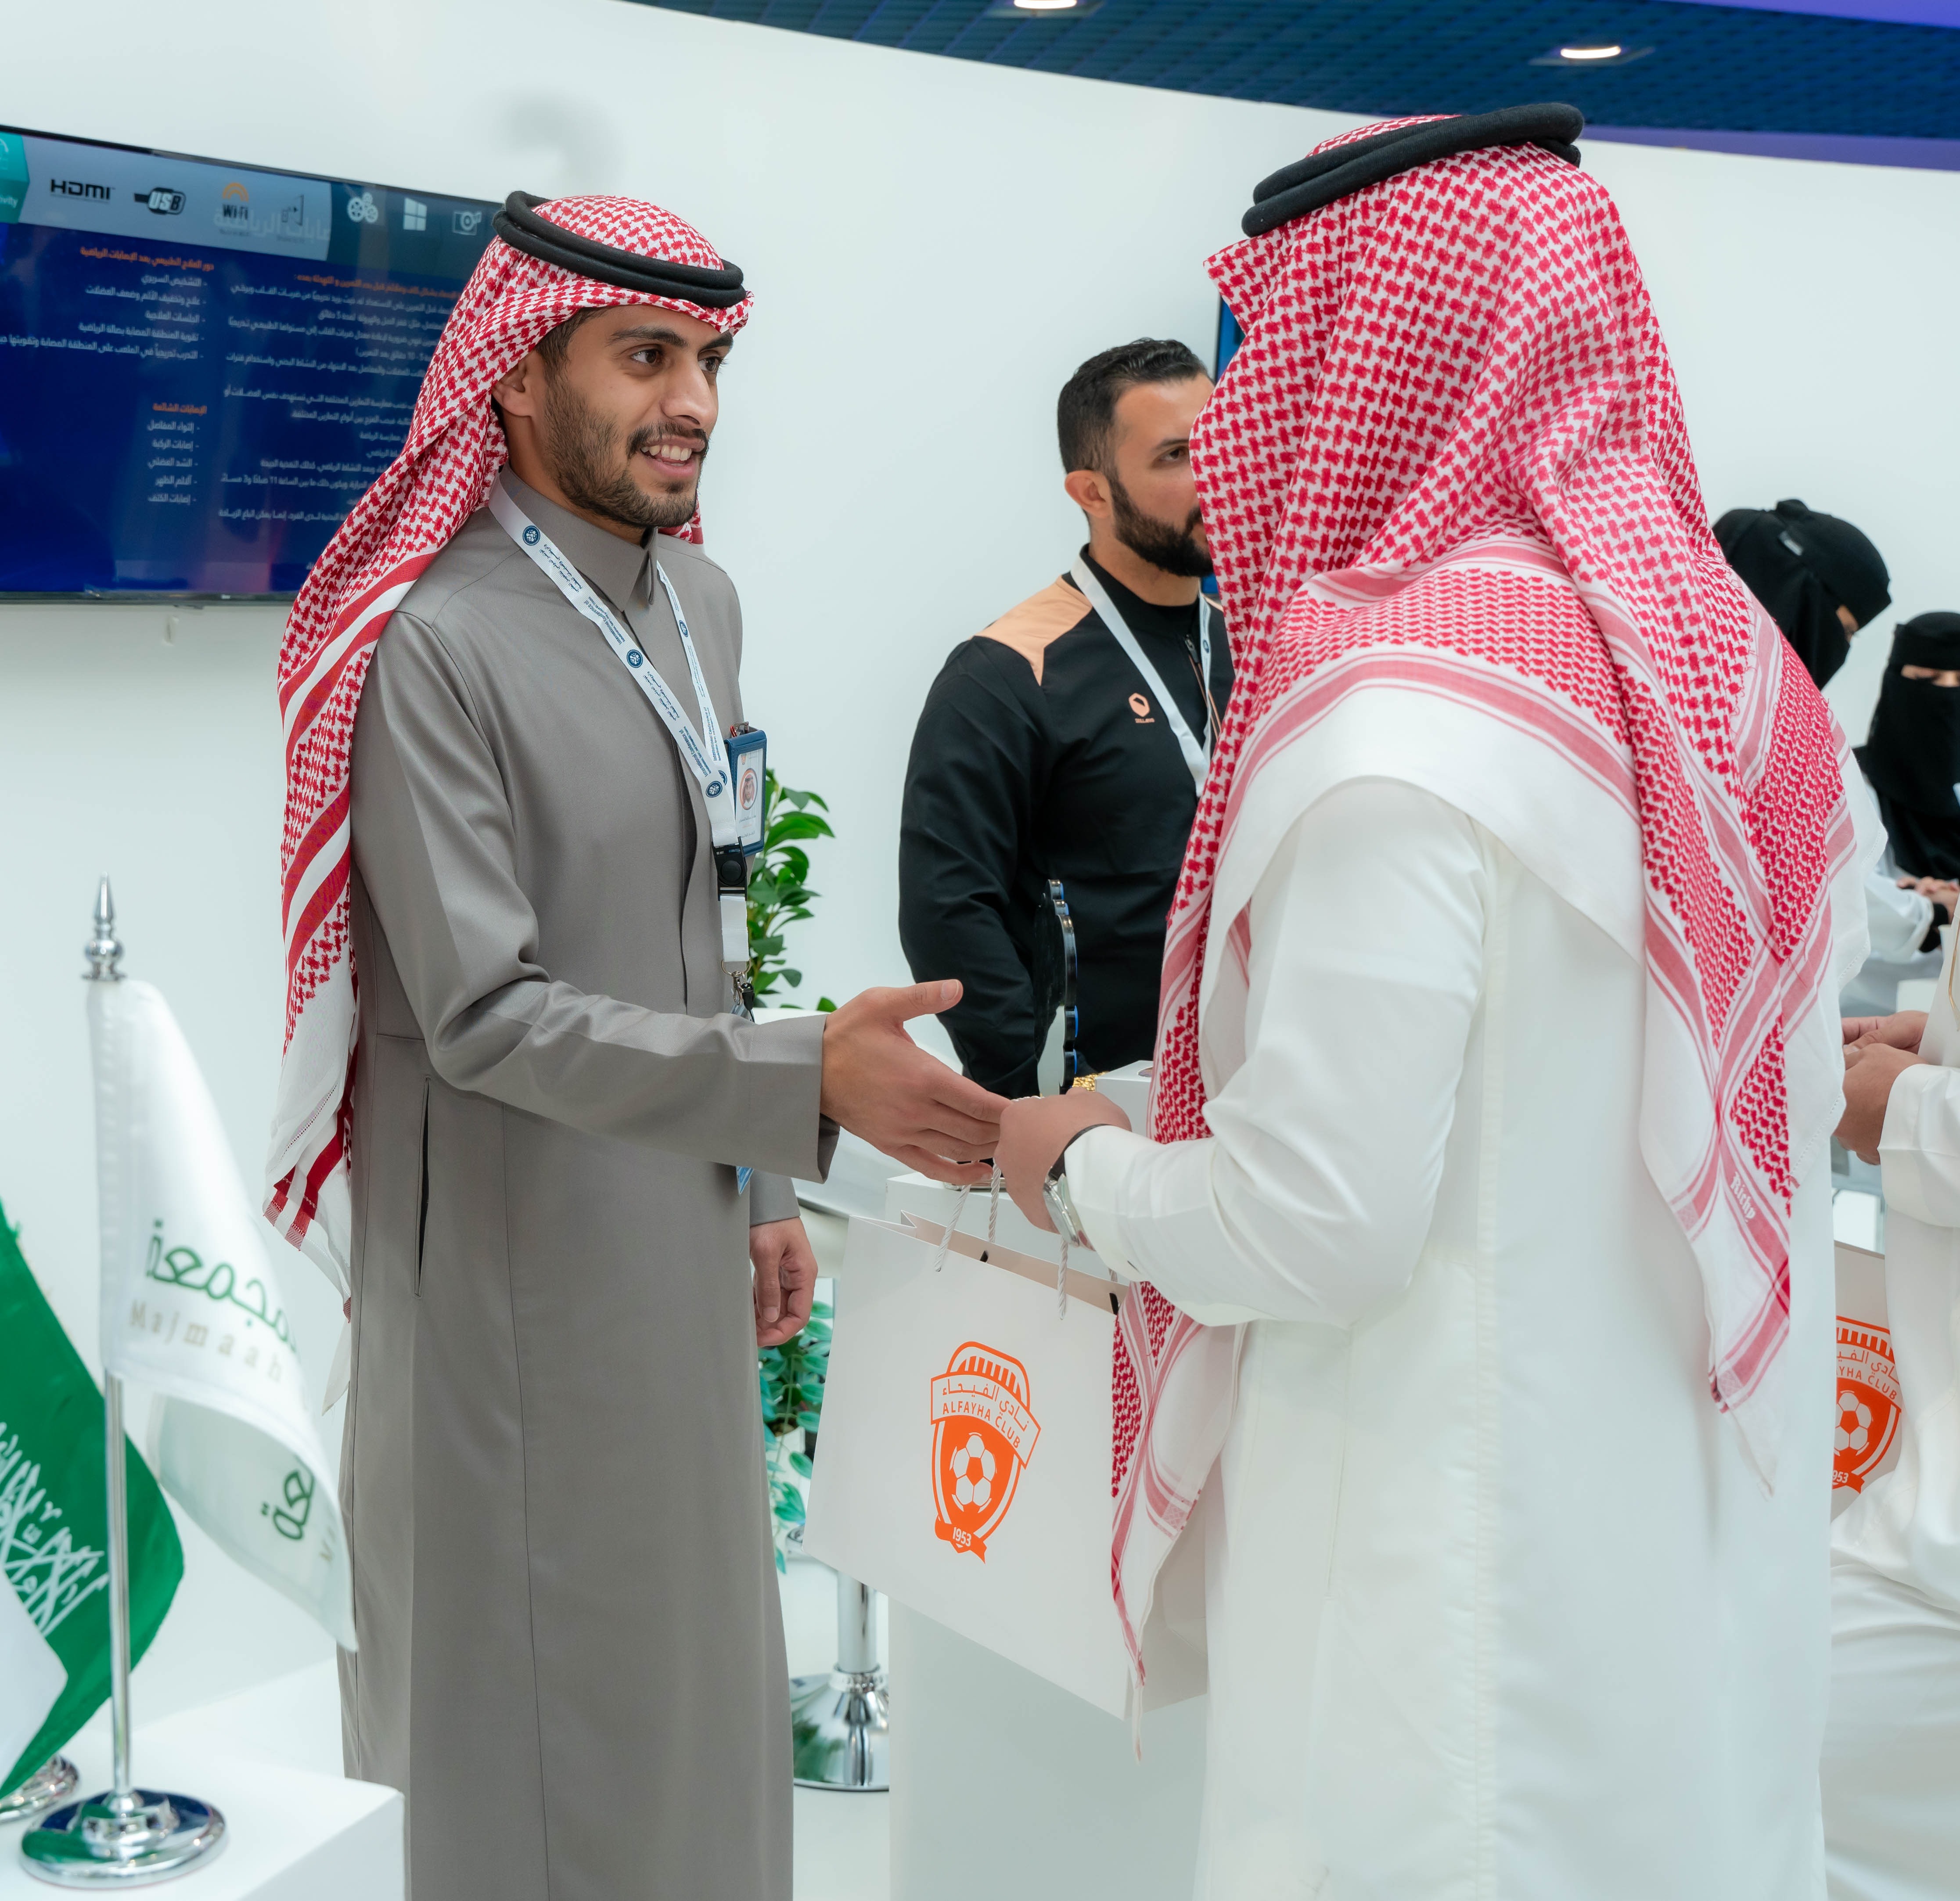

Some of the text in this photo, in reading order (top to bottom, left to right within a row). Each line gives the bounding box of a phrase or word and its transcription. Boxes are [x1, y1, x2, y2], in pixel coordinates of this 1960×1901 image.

[50, 179, 110, 200] HDMI
[149, 191, 181, 211] USB
[588, 604, 607, 622] Conference
[605, 621, 622, 644] International
[682, 733, 695, 755] Conference
[692, 753, 708, 777] International
[1837, 1350, 1869, 1364] الفي
[1870, 1362, 1900, 1386] ادي
[1868, 1375, 1897, 1400] CLUB
[942, 1379, 1029, 1431] نادي الفيحاء
[943, 1401, 1025, 1448] ALFAYHA CLUB
[1833, 1470, 1849, 1484] 953
[953, 1527, 971, 1547] 1953
